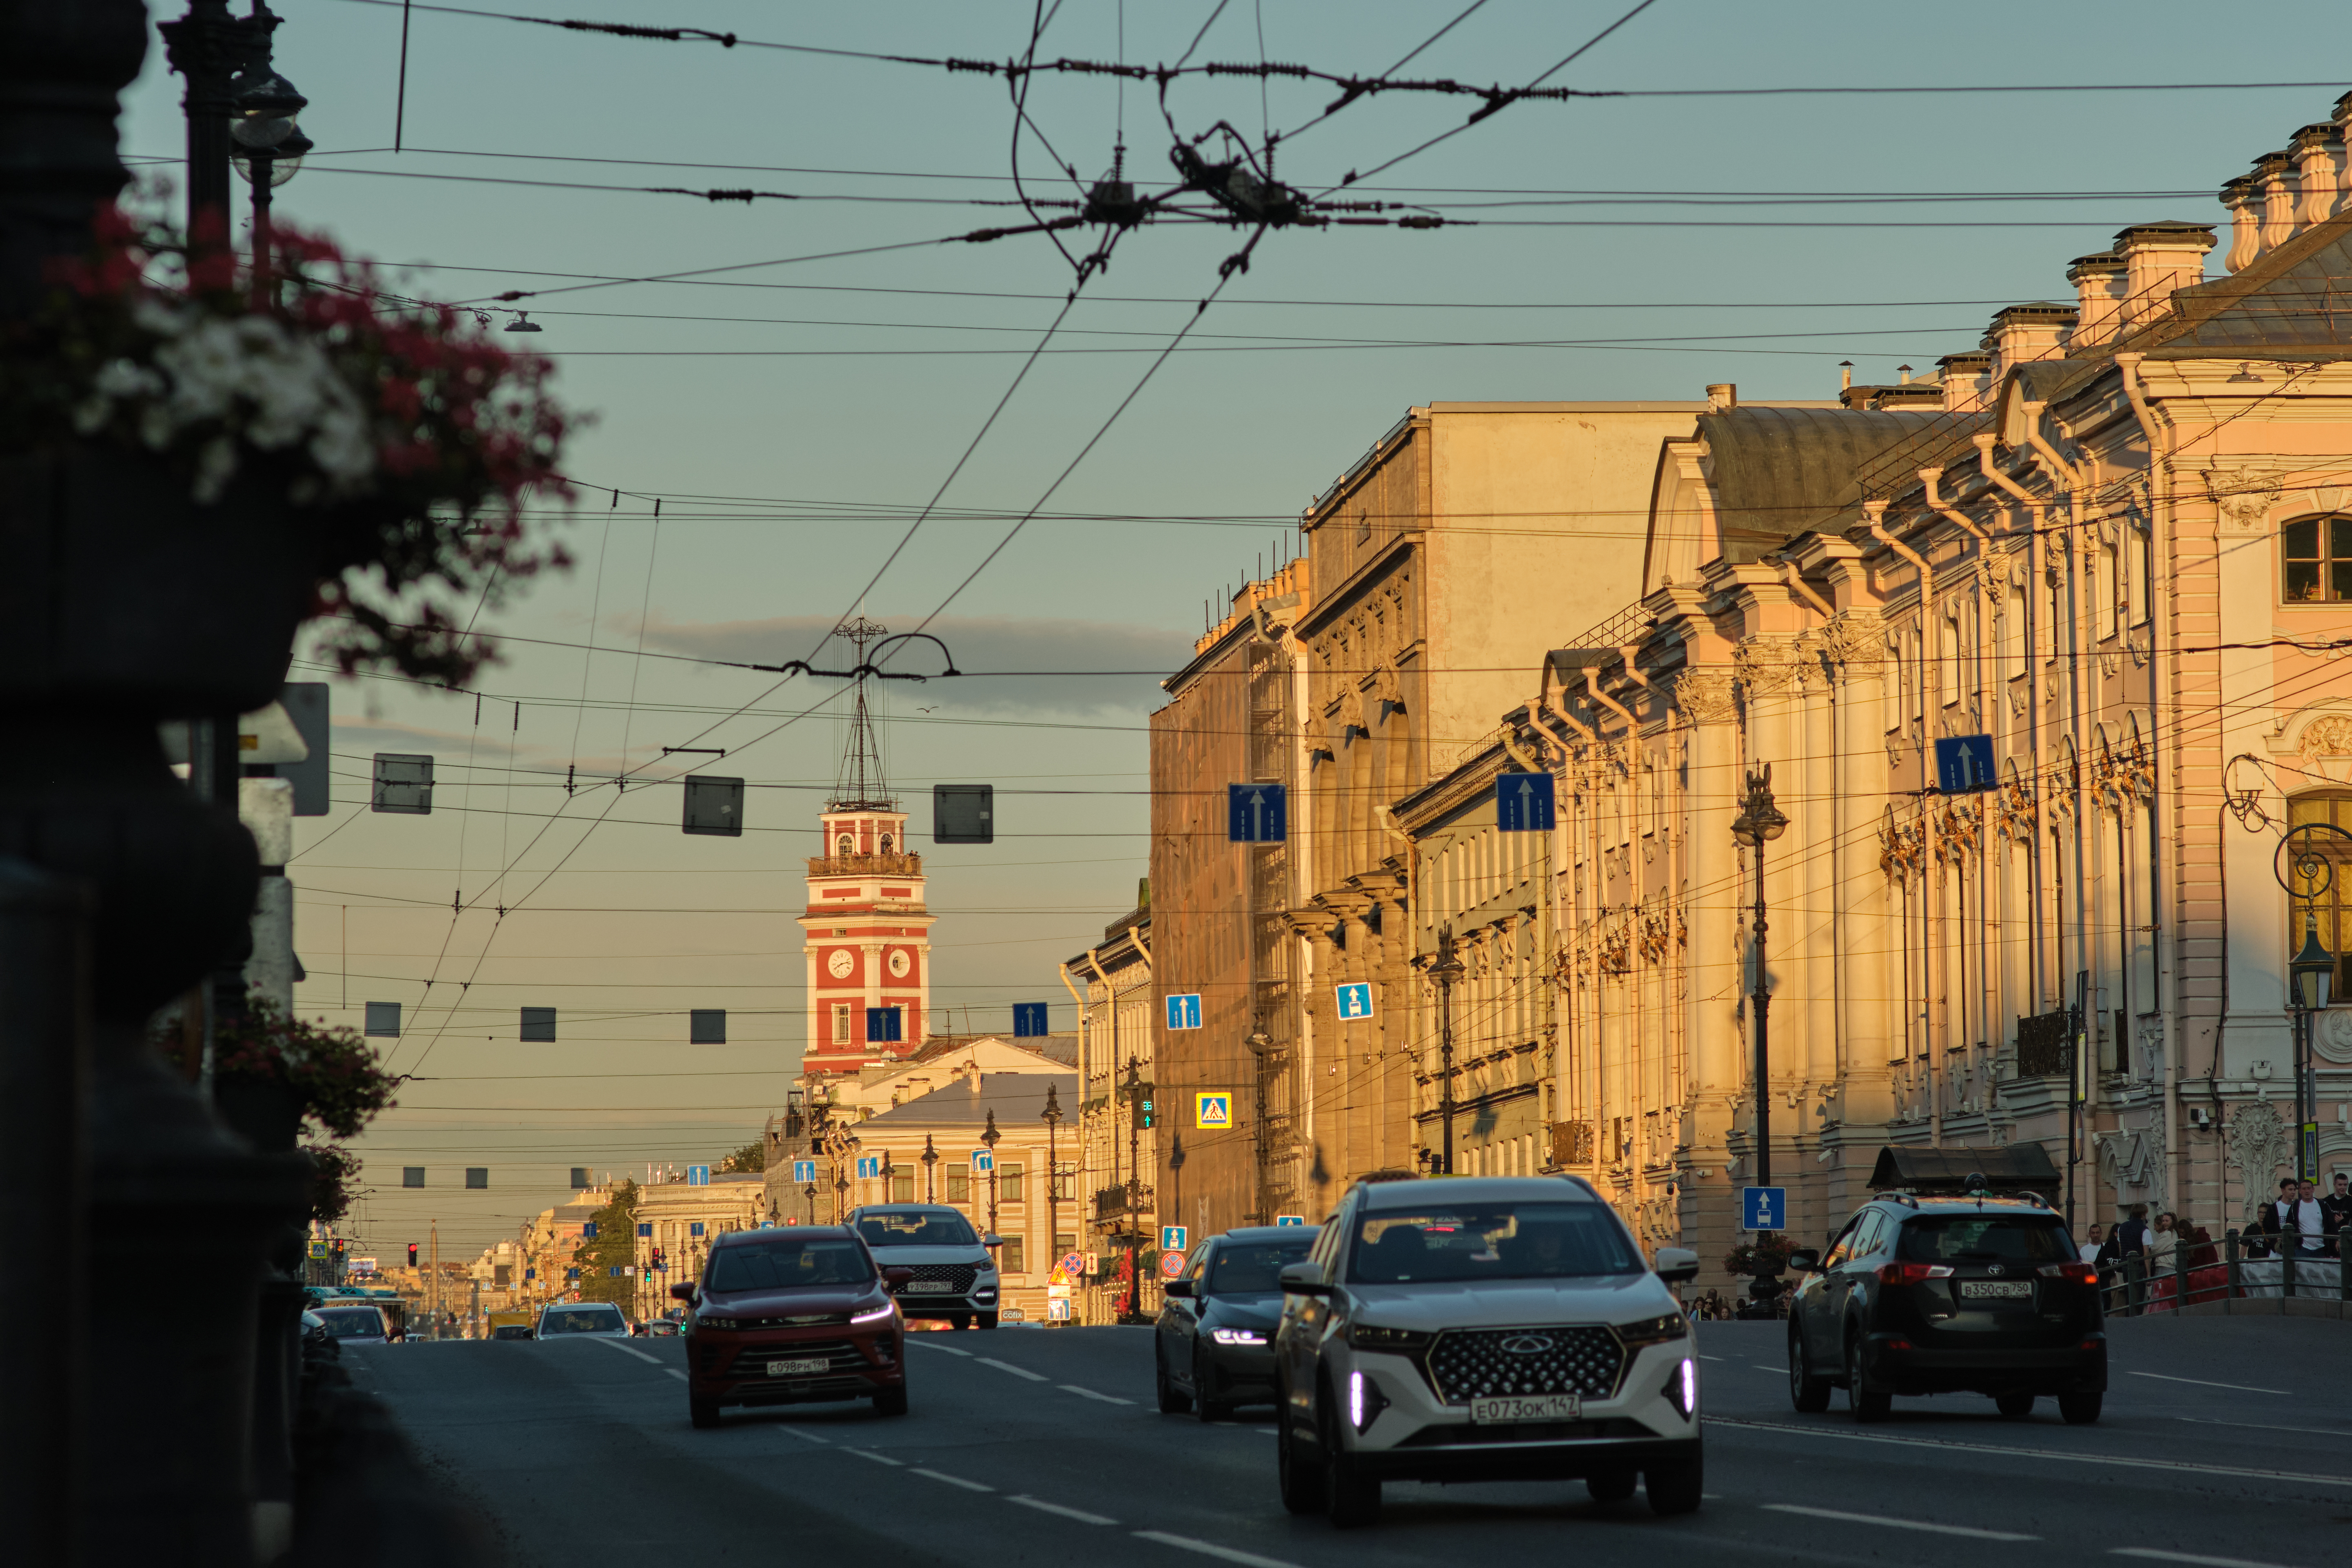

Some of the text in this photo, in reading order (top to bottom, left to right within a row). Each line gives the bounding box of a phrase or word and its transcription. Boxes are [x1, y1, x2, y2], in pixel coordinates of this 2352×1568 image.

[1143, 1101, 1152, 1110] 36
[2011, 1283, 2028, 1292] 750
[1002, 1311, 1022, 1319] cofix
[811, 1359, 827, 1367] 198
[1550, 1397, 1575, 1414] 147
